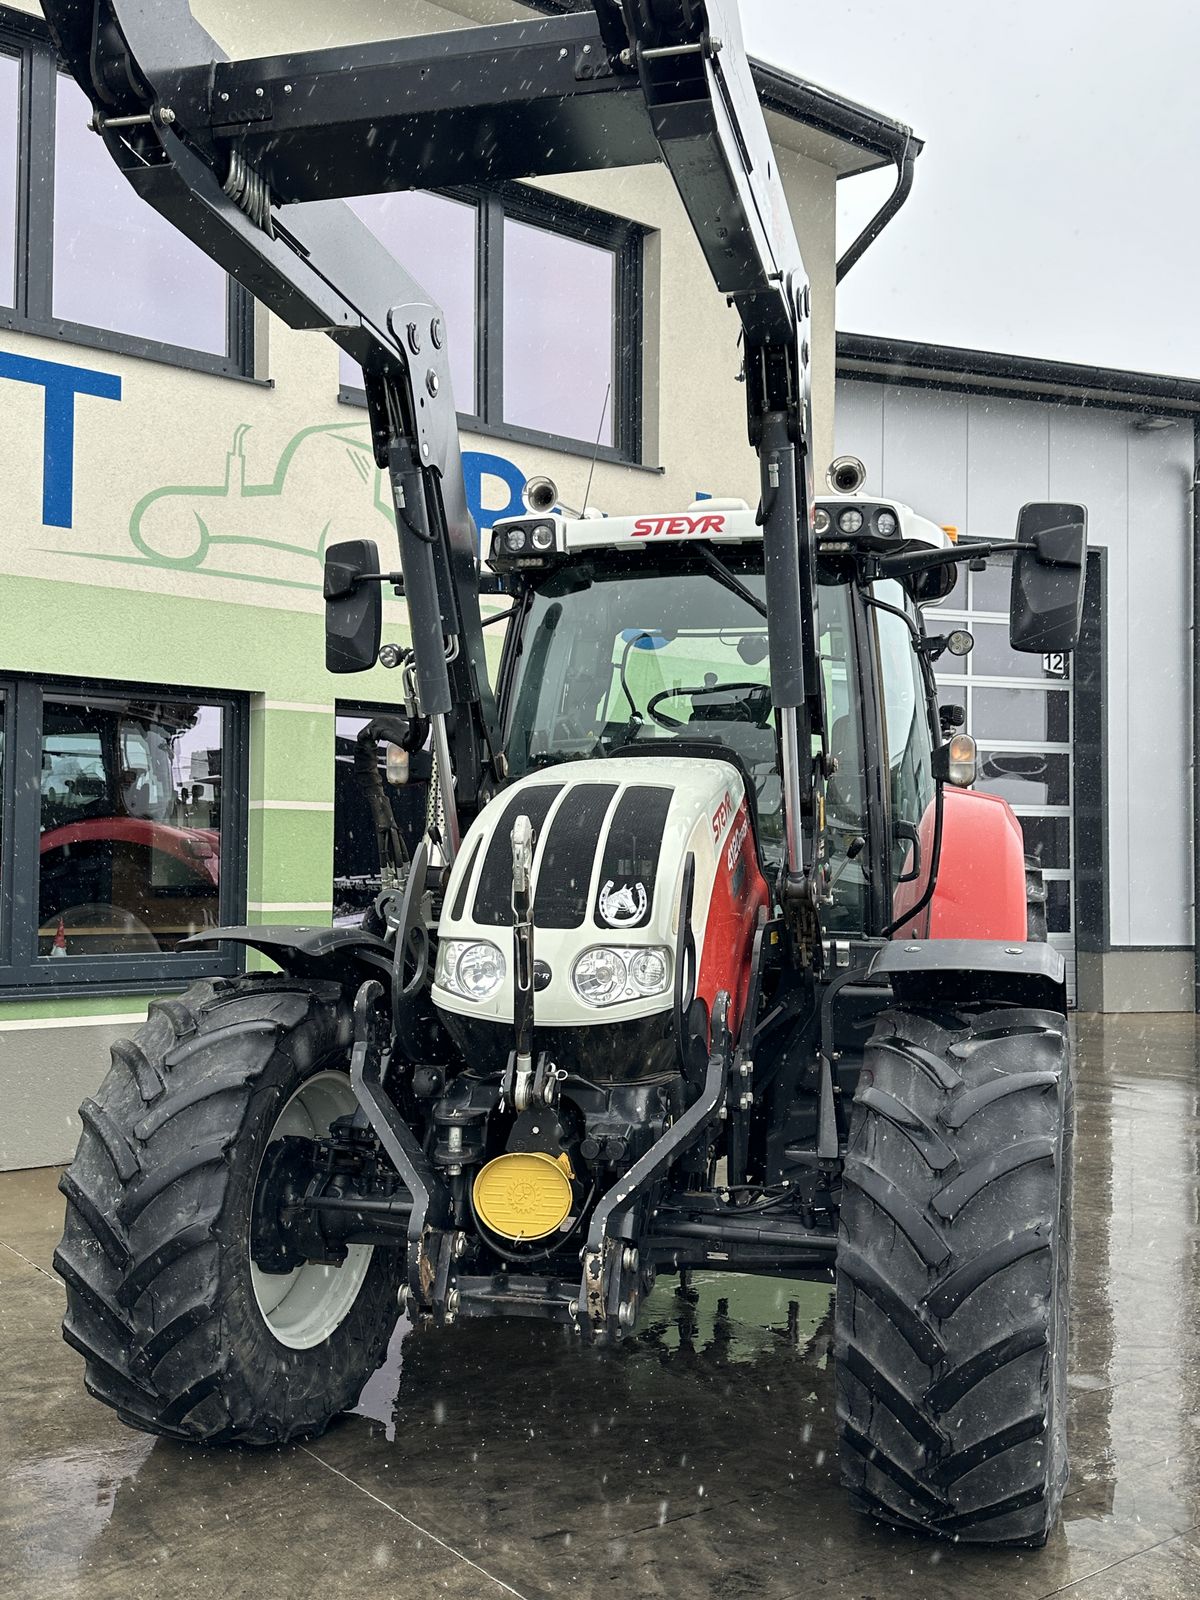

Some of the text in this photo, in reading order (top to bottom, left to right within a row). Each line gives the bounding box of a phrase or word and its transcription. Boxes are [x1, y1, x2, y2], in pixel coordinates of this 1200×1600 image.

[630, 515, 725, 537] STEYR
[1044, 653, 1063, 670] 12
[712, 790, 732, 845] STEYR
